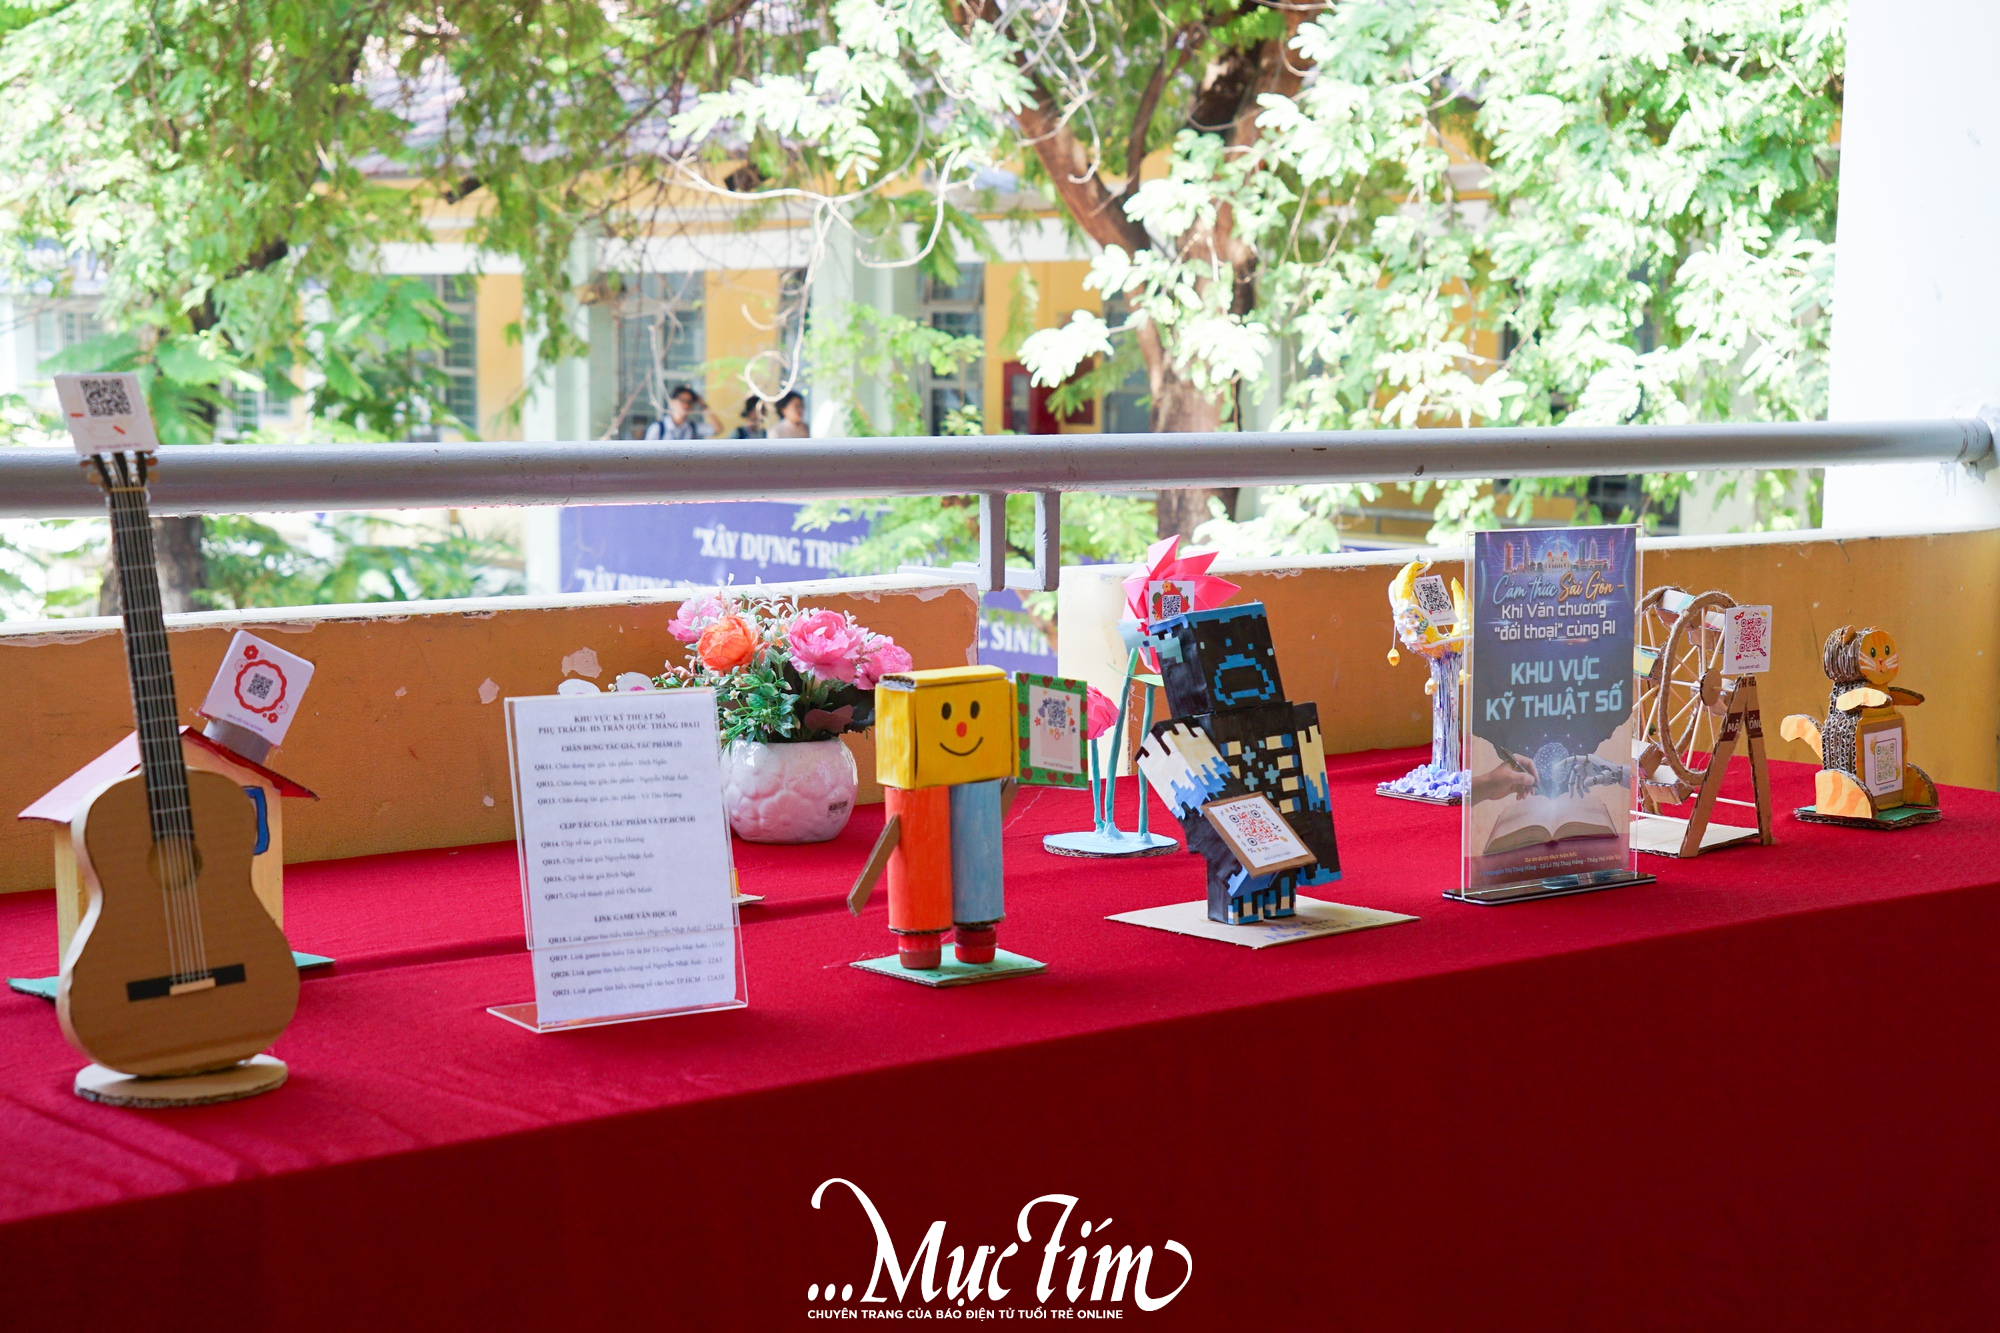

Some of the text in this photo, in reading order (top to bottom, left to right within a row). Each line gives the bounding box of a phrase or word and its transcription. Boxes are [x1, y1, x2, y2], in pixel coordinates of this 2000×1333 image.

[742, 533, 801, 569] DỰNG
[1492, 574, 1527, 605] Cảm
[1528, 573, 1557, 603] thức
[1558, 571, 1583, 603] Sài
[1585, 570, 1614, 602] Gòn
[1501, 601, 1607, 619] Khi Văn chương
[1566, 621, 1599, 639] cùng
[1602, 620, 1616, 635] AI
[1511, 655, 1600, 686] KHU VỰC
[1486, 679, 1624, 721] KỸ THUẬT SỐ
